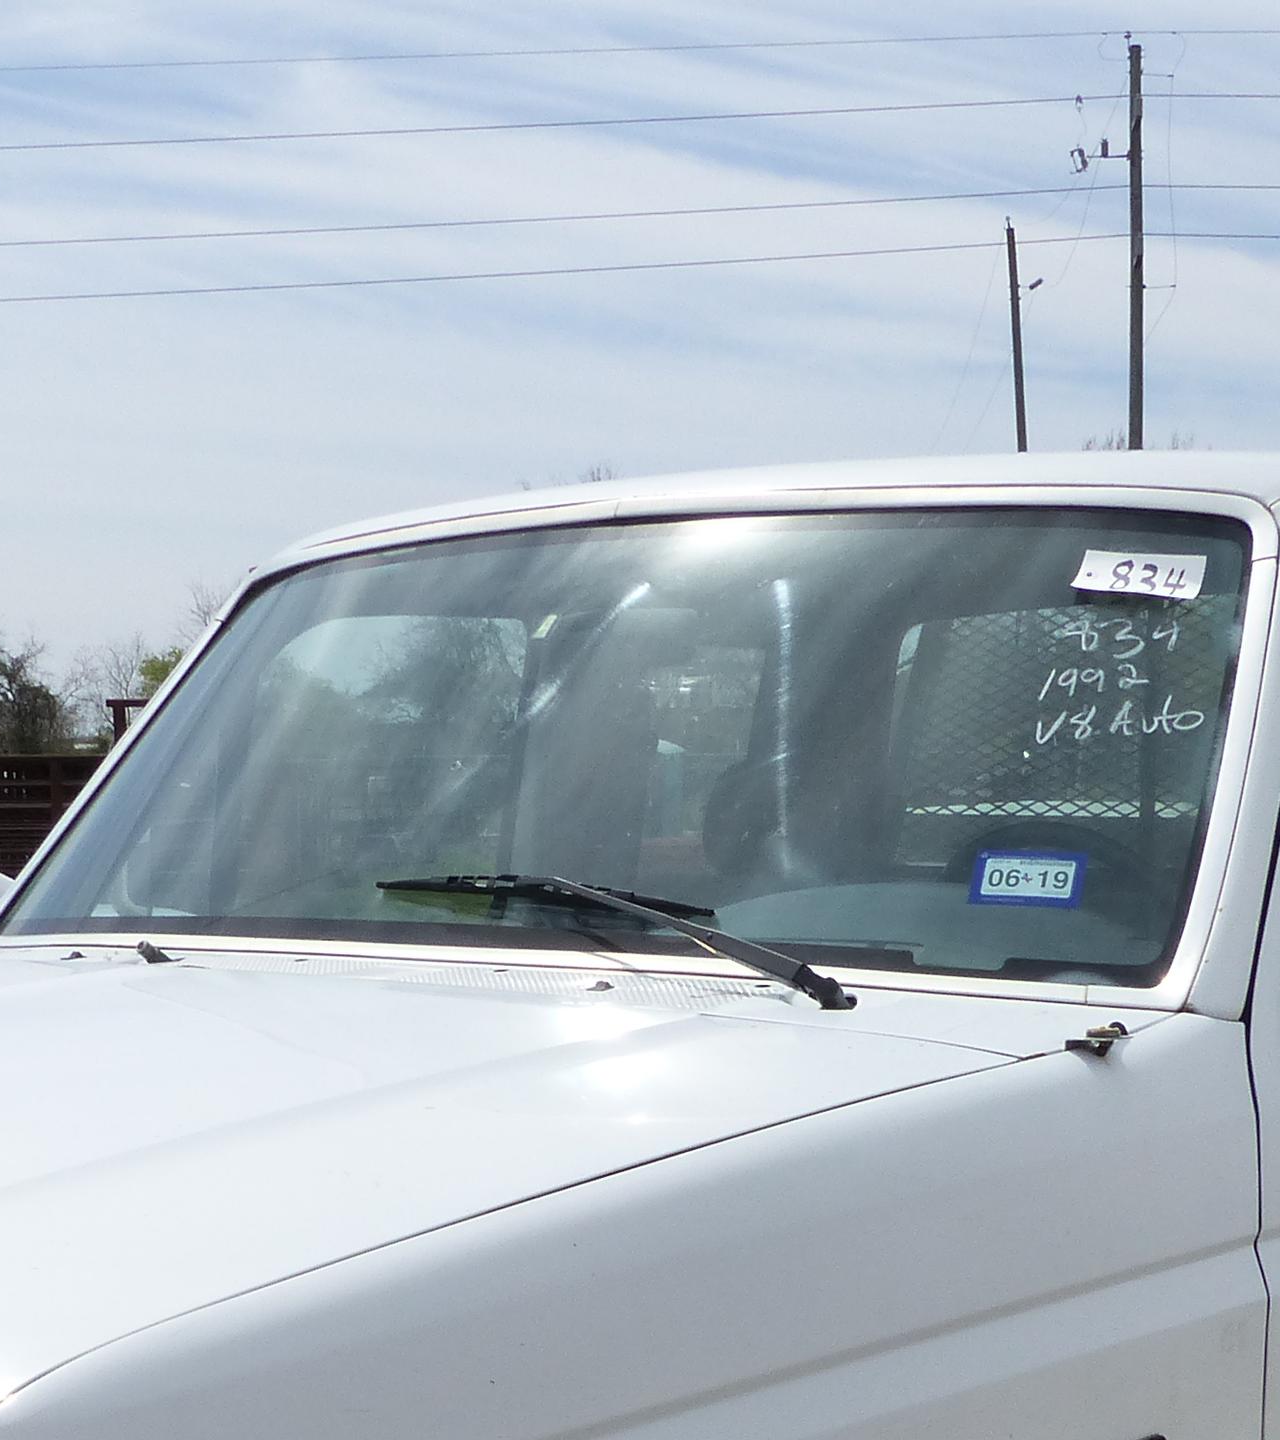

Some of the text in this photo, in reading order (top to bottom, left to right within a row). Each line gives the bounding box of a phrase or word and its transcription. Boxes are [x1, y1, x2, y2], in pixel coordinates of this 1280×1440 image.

[1109, 560, 1186, 595] 834
[1063, 618, 1180, 659] 834
[1037, 663, 1150, 701] 1992
[1109, 695, 1205, 736] Auto
